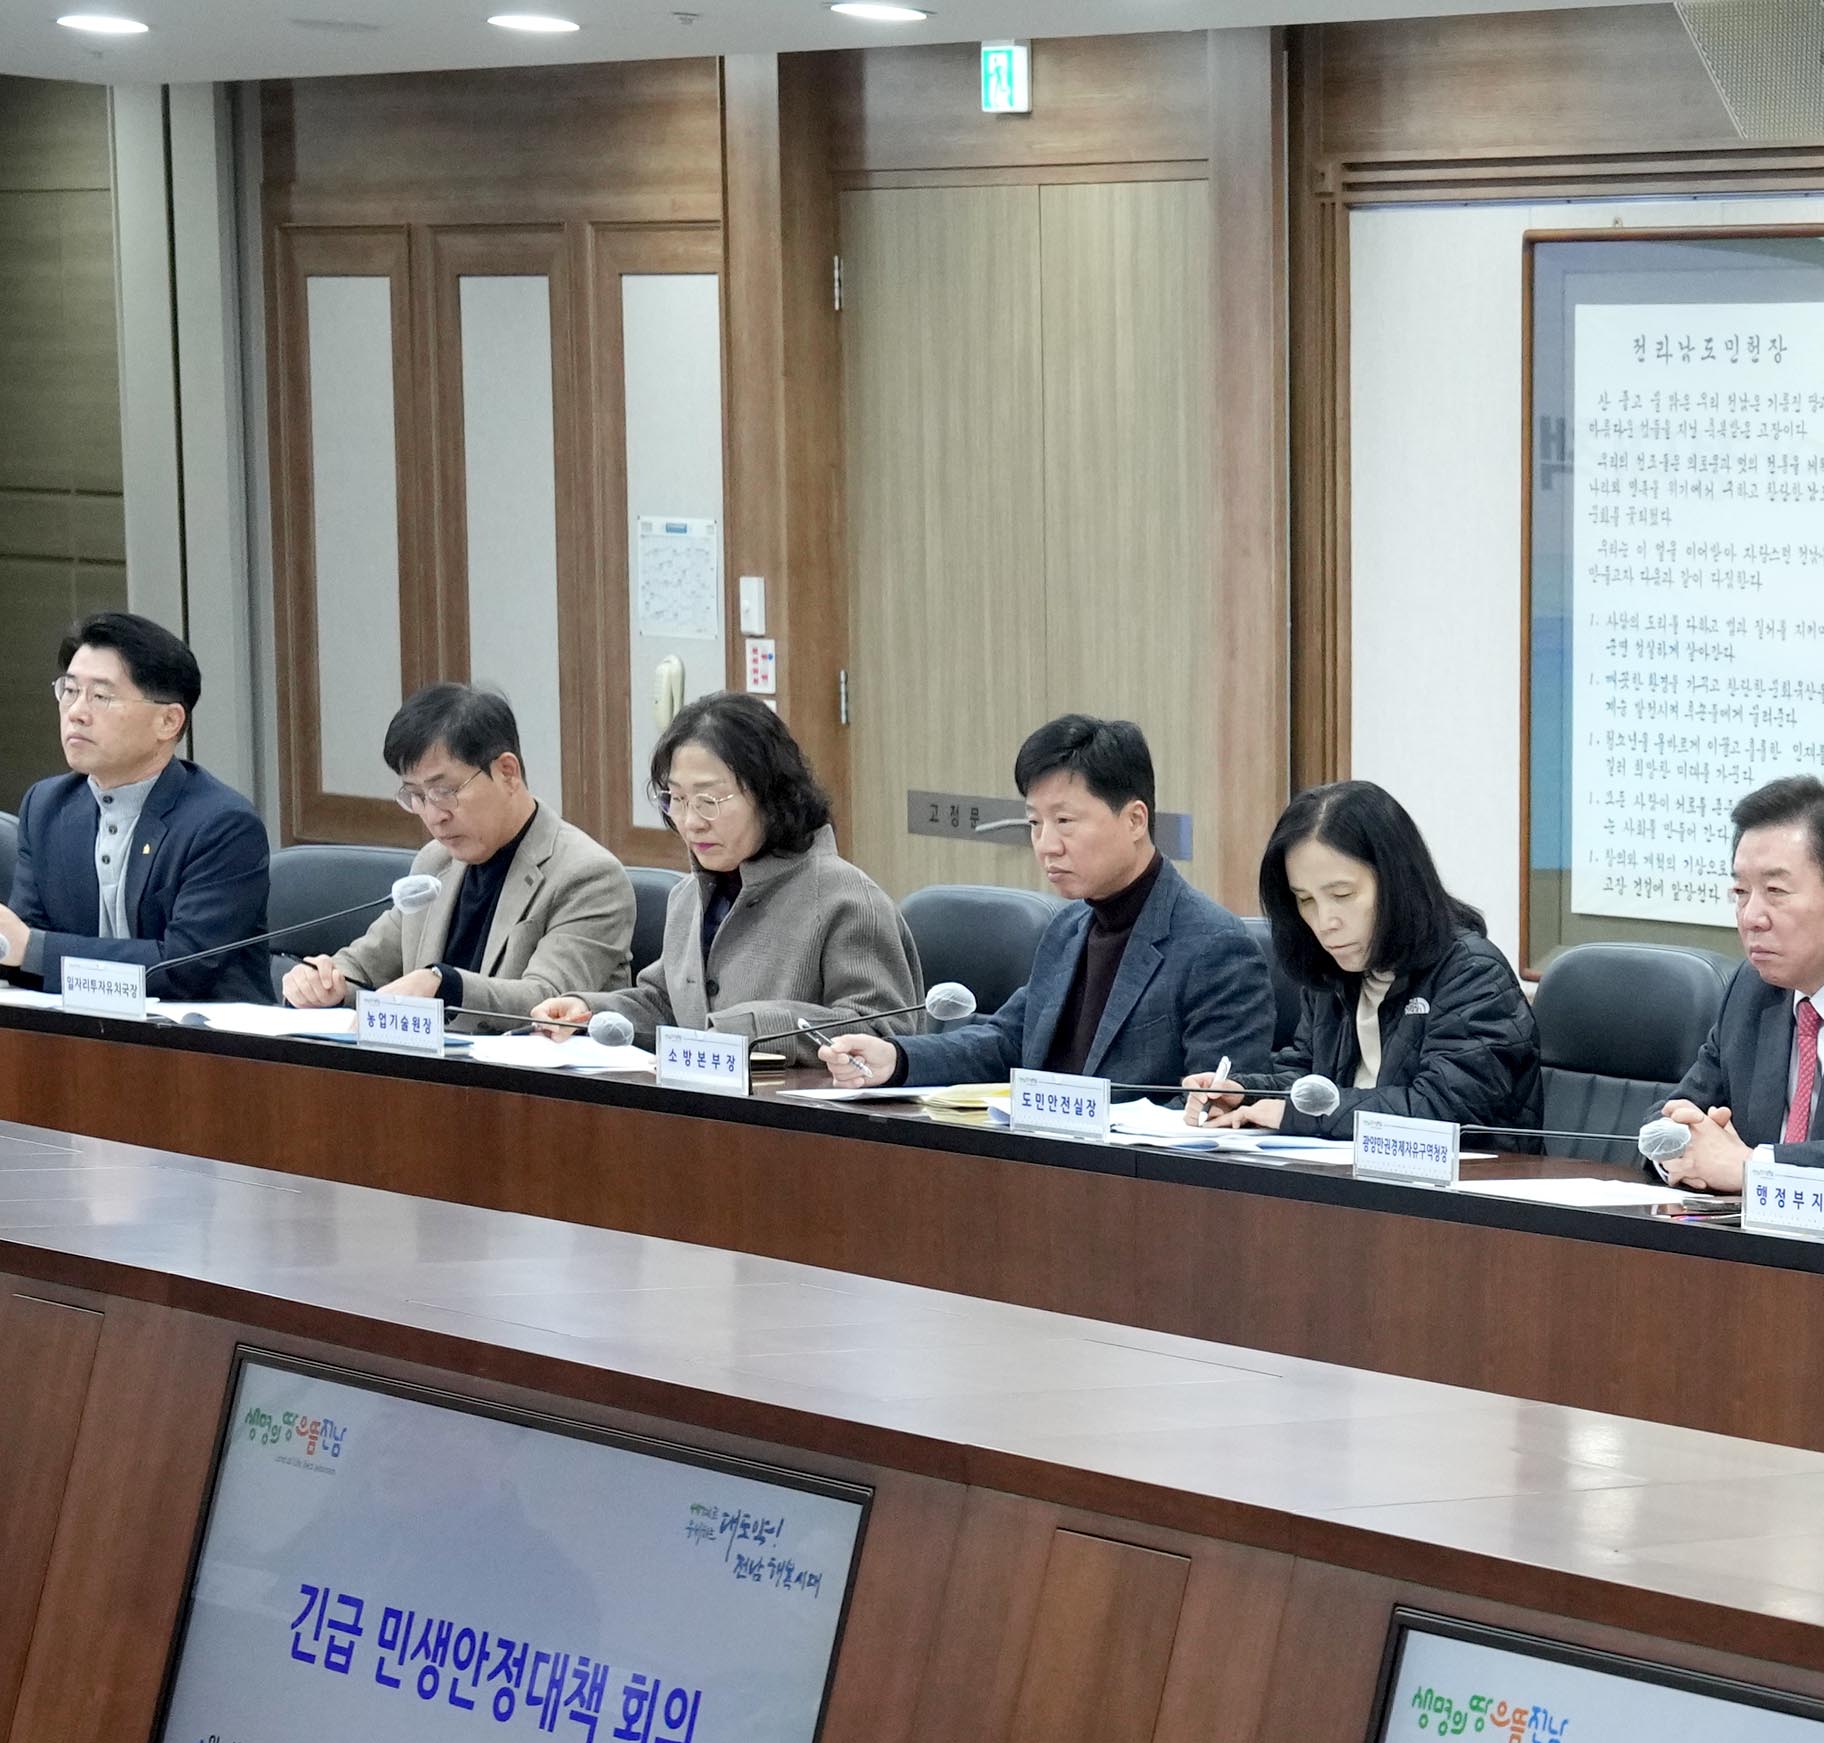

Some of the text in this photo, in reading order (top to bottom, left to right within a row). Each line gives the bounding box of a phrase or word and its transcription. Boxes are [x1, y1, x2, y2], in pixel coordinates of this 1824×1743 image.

[66, 975, 138, 999] 일자리투자유치국장
[367, 1011, 431, 1034] 농업기술원장
[668, 1048, 735, 1072] 소방본부장
[1022, 1092, 1096, 1117] 도민안전실장
[1363, 1136, 1448, 1163] 광양만권경제자유구역청장
[291, 1583, 364, 1674] 긴급
